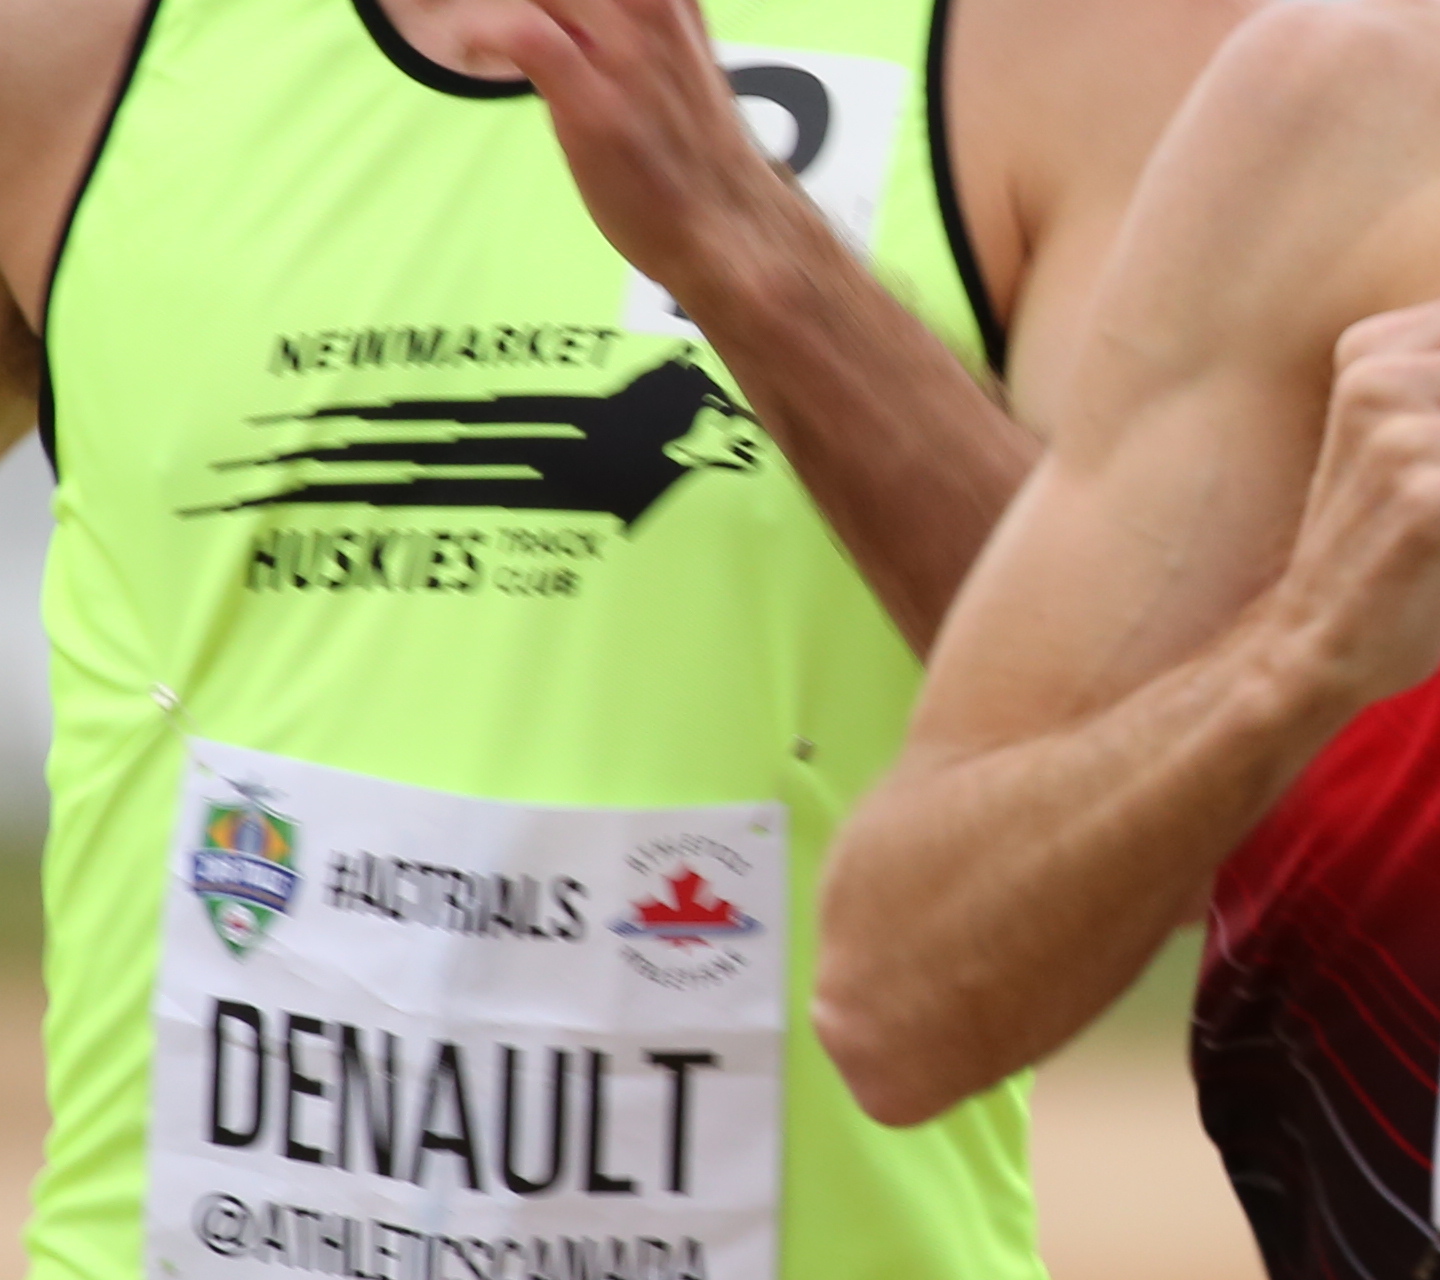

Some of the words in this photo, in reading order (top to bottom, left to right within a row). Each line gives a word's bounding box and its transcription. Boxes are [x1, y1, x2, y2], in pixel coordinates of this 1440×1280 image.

[268, 324, 622, 376] NEWMARKET
[245, 527, 488, 593] HUSKIES
[497, 527, 605, 562] TRACK
[492, 565, 582, 597] CLUB
[324, 849, 589, 942] #ACTRIALS
[205, 996, 719, 1197] DENAULT
